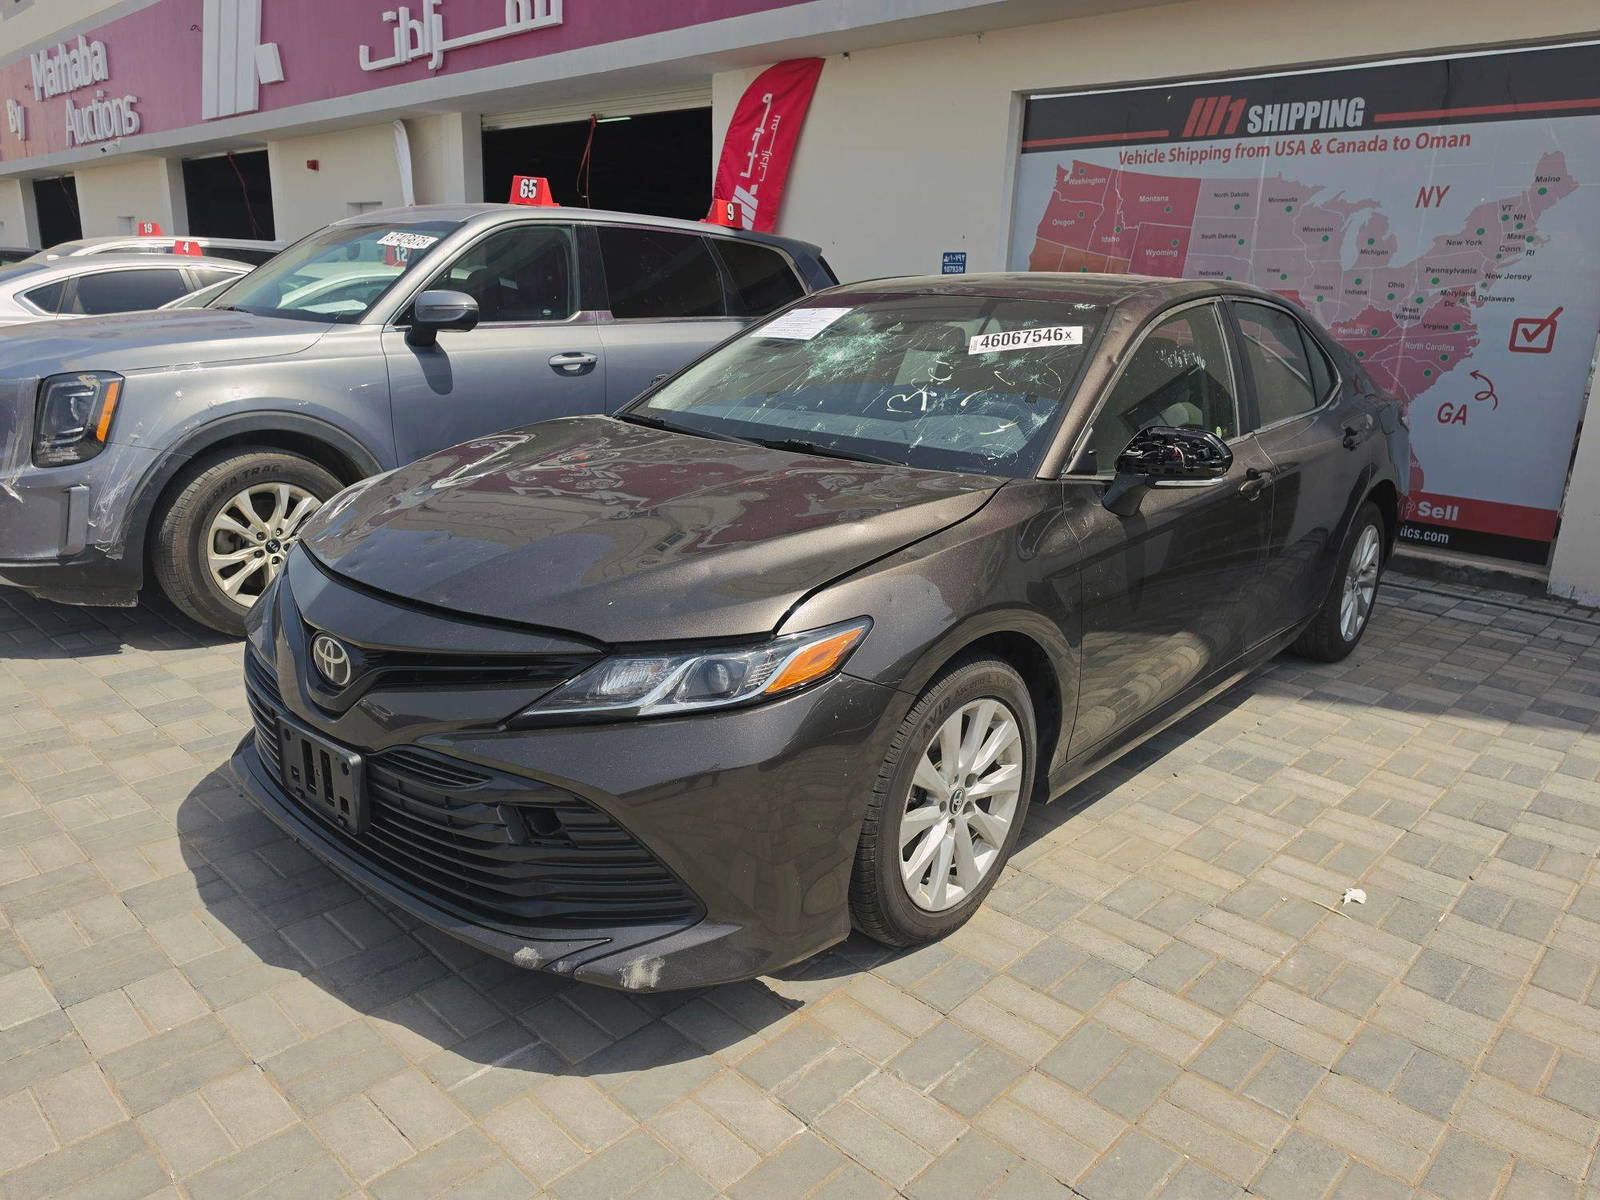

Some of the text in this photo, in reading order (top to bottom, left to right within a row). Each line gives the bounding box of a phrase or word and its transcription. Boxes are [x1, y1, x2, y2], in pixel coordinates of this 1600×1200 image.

[30, 35, 109, 101] Marhaba
[6, 98, 26, 141] By
[65, 90, 141, 146] Auctions
[1247, 97, 1366, 134] SHIPPING
[739, 93, 774, 178] مرحبا
[1119, 132, 1471, 165] Vehicle Shipping from USA & Canada to Oman
[1069, 177, 1106, 186] Washington
[1535, 175, 1561, 184] Maine
[520, 178, 538, 199] 65
[1415, 184, 1452, 209] NY
[727, 203, 734, 221] 9
[1501, 204, 1513, 212] VT
[1513, 213, 1527, 221] NH
[1052, 218, 1075, 227] Oregon
[143, 223, 153, 234] 19
[183, 241, 190, 254] 4
[1465, 239, 1483, 247] York
[1145, 248, 1179, 257] Wyoming
[1360, 248, 1389, 257] Michigan
[1525, 249, 1535, 257] RI
[1425, 267, 1477, 276] Pennsylvania
[1485, 272, 1533, 283] New Jersey
[1388, 281, 1405, 289] Ohio
[1440, 288, 1476, 297] Maryland
[1478, 294, 1515, 303] Delaware
[1395, 313, 1421, 321] Virginia
[1338, 327, 1367, 337] Kentucky
[1423, 323, 1449, 331] Virginia
[1405, 342, 1455, 352] North Carolina
[1437, 402, 1468, 426] GA
[1417, 500, 1459, 521] Sell
